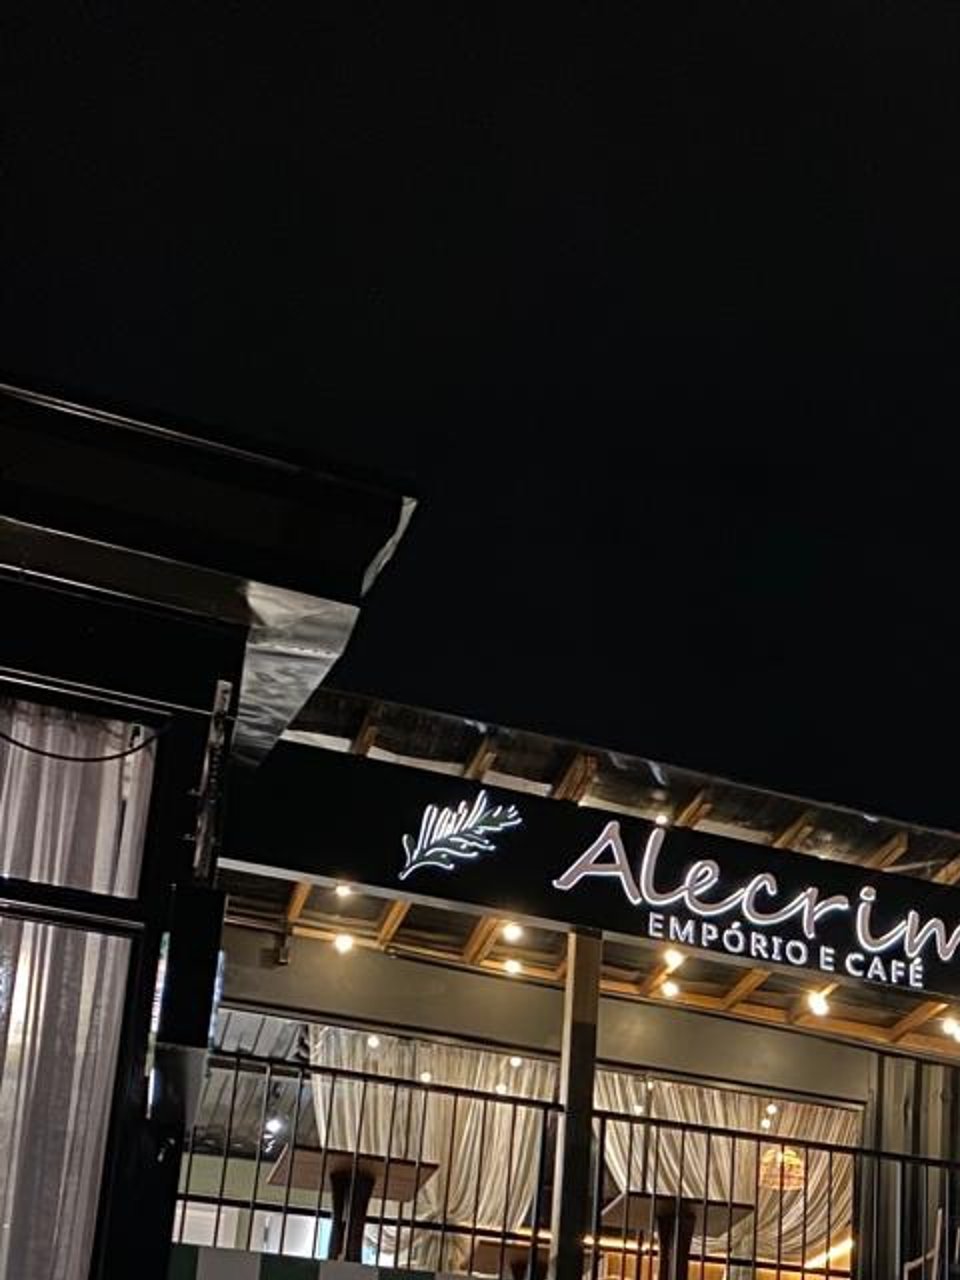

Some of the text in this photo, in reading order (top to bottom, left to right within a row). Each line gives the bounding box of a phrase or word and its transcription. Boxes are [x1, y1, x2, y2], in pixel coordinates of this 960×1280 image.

[648, 911, 924, 988] EMPÓRIO E CAFÉ
